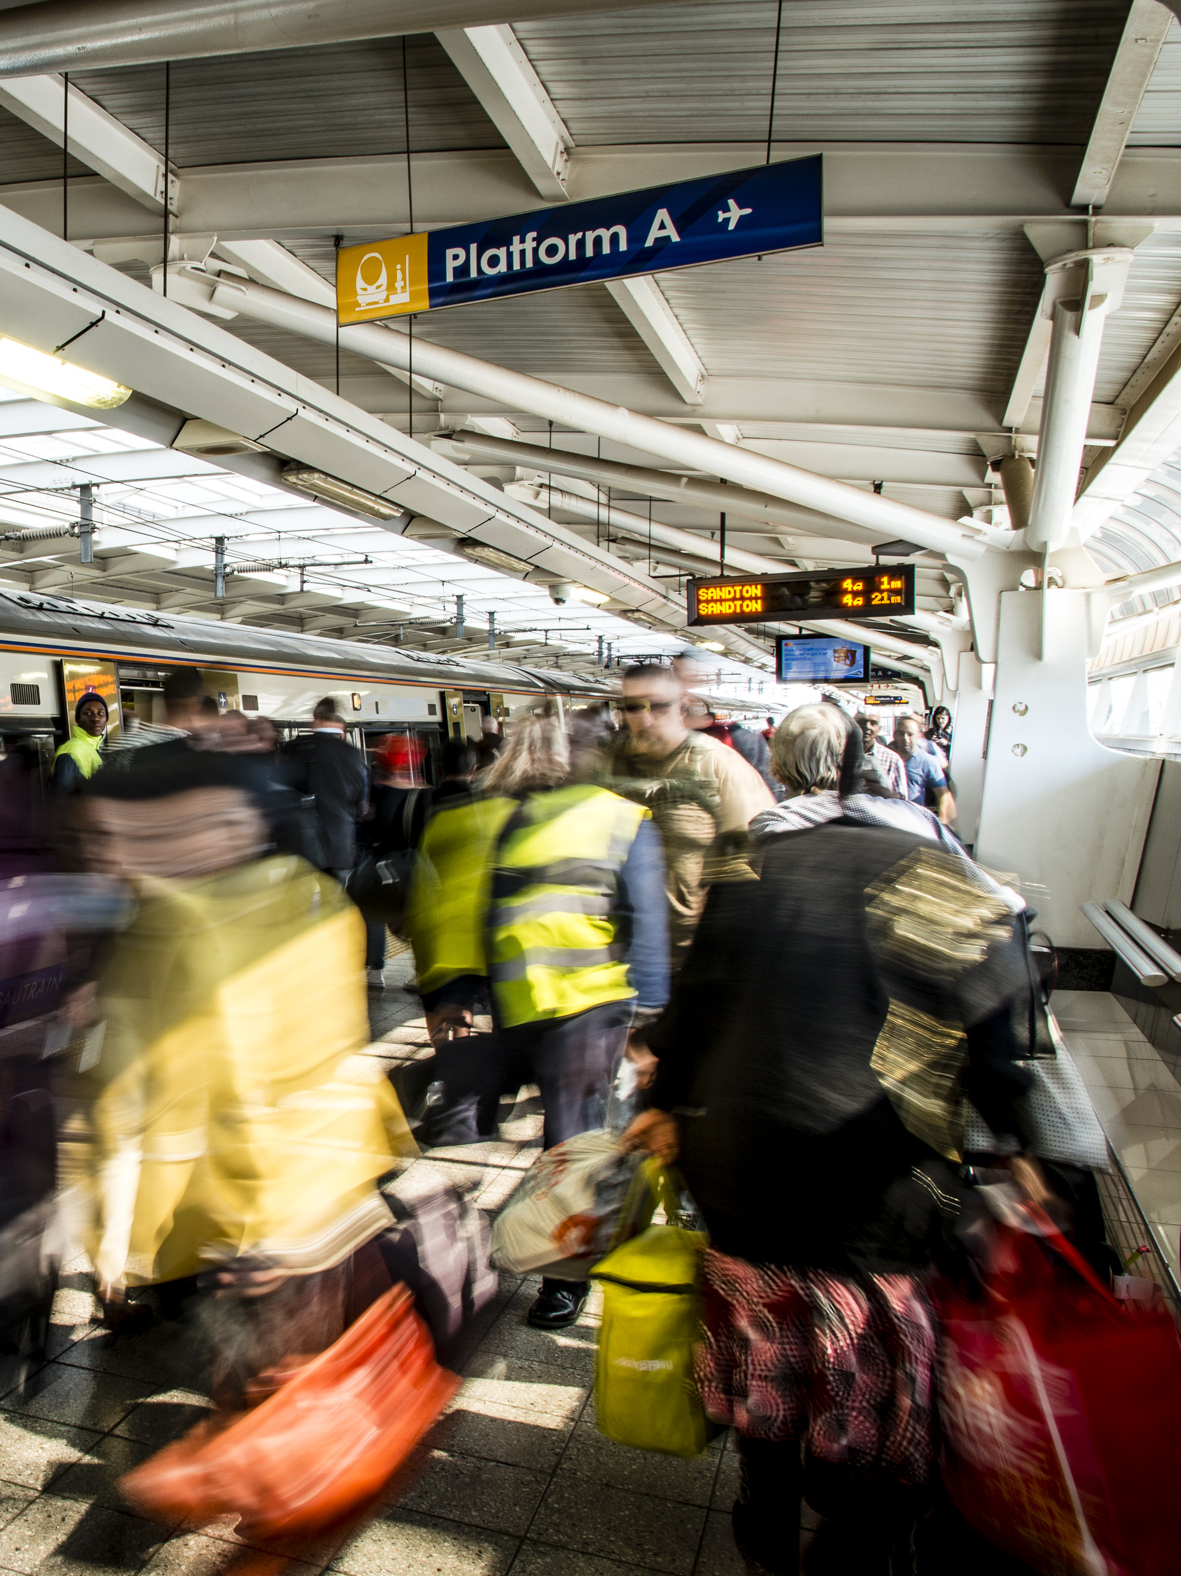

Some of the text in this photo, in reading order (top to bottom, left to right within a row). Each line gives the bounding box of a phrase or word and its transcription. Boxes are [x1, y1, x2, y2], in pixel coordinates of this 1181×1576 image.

[445, 207, 681, 283] Platform A
[698, 584, 762, 600] SANDTON
[880, 575, 902, 589] 1m
[698, 599, 762, 615] SANDTON
[871, 591, 902, 605] 21m
